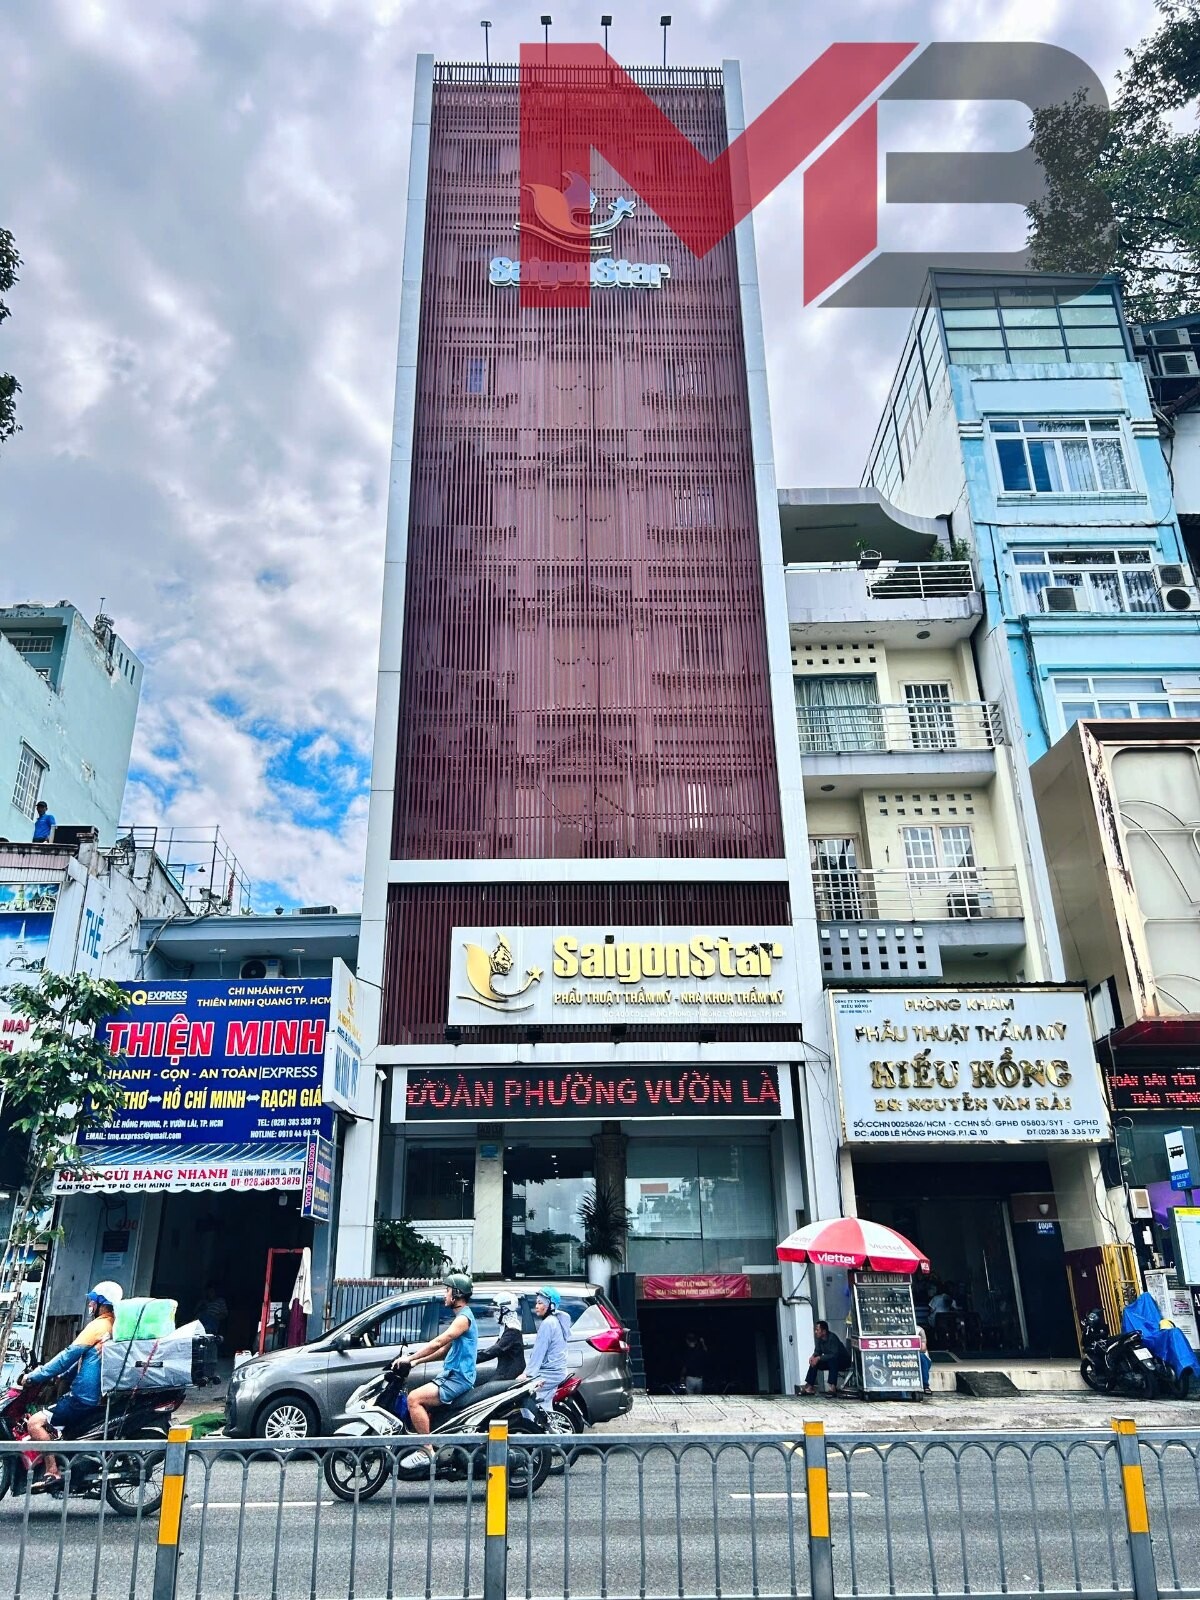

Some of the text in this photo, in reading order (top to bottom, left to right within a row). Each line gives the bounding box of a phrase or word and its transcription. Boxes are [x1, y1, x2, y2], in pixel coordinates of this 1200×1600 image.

[489, 256, 671, 291] SaigonStar
[553, 935, 783, 983] SaigonStar
[147, 990, 188, 1000] EXPRESS
[228, 985, 304, 995] CHI NHÁNH CTY
[704, 991, 734, 1005] KHOA
[197, 996, 332, 1007] THIÊN MINH QUANG TP. HCM
[904, 995, 1015, 1012] PHÒNG KHÁM
[2, 1019, 30, 1035] MẠI
[854, 1016, 1068, 1045] PHẪU THUẬT THẨM MỸ
[106, 1014, 215, 1066] THIỆN
[225, 1019, 326, 1057] MINH
[160, 1068, 190, 1082] GỌN
[199, 1069, 220, 1079] AN
[220, 1065, 258, 1079] TOÀN
[261, 1066, 318, 1079] EXPRESS
[869, 1046, 1073, 1089] HIẾU HỒNG
[504, 1071, 637, 1107] PHƯỜNG
[644, 1070, 732, 1104] VƯỜN
[162, 1084, 182, 1110] HỒ
[184, 1086, 209, 1109] CHÍ
[210, 1090, 247, 1109] MINH
[260, 1088, 297, 1112] RẠCH
[300, 1085, 323, 1107] GIÁ
[907, 1091, 988, 1112] NGUYỄN
[953, 1119, 980, 1128] CCHN
[1071, 1128, 1086, 1136] 335
[177, 1168, 229, 1180] NHANH
[868, 1338, 912, 1349] SEIKO
